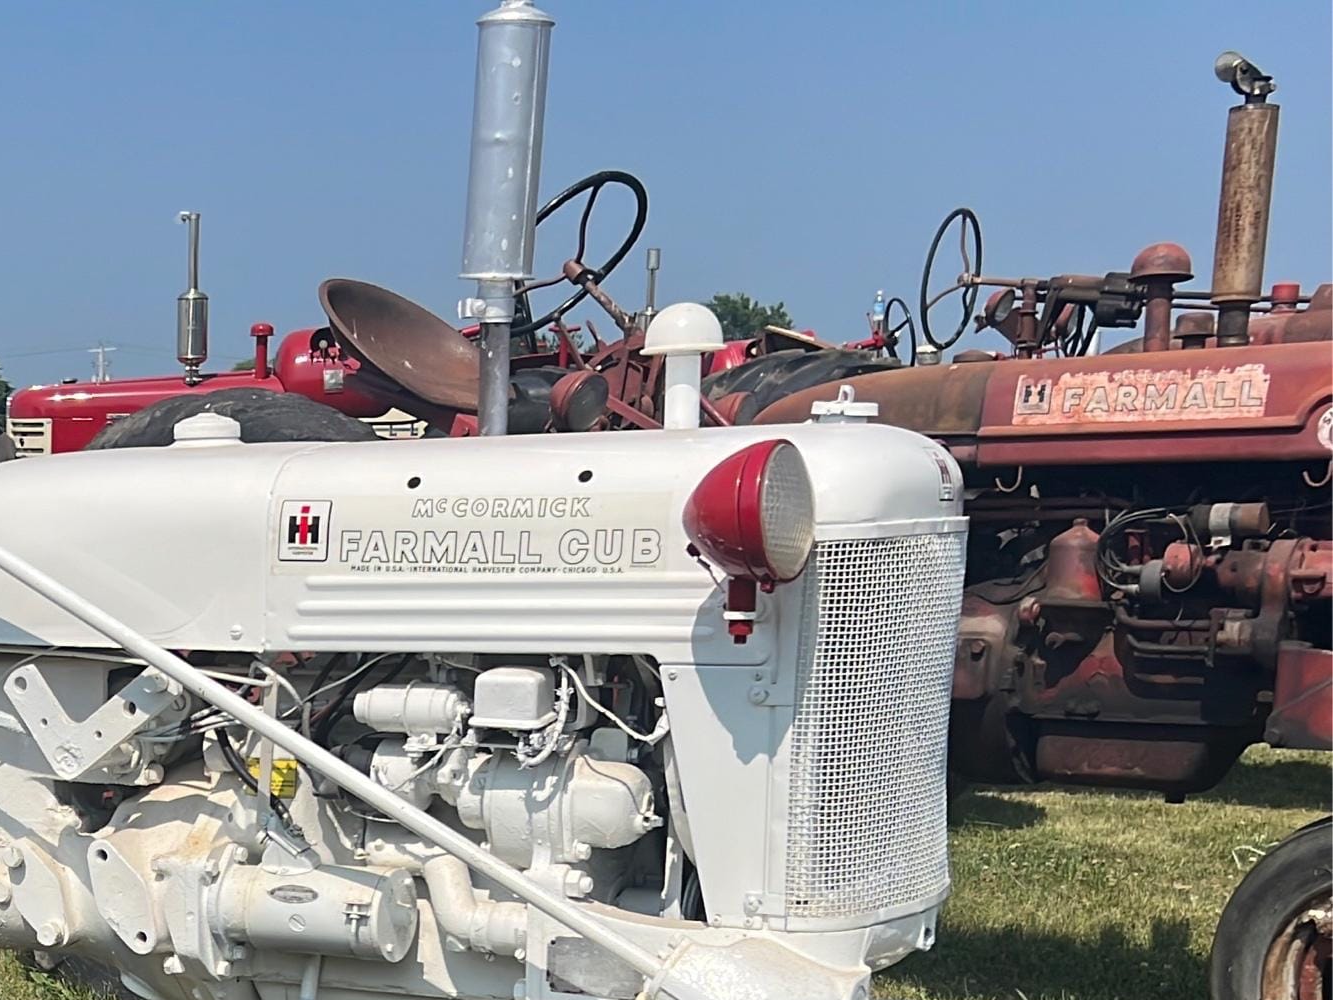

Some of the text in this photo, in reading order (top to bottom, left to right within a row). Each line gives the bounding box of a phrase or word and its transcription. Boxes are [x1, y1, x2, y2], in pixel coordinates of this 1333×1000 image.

[1062, 380, 1263, 414] FARMALL
[339, 528, 662, 565] FARMALL CUB
[350, 565, 370, 573] MADE
[373, 565, 382, 573] IN
